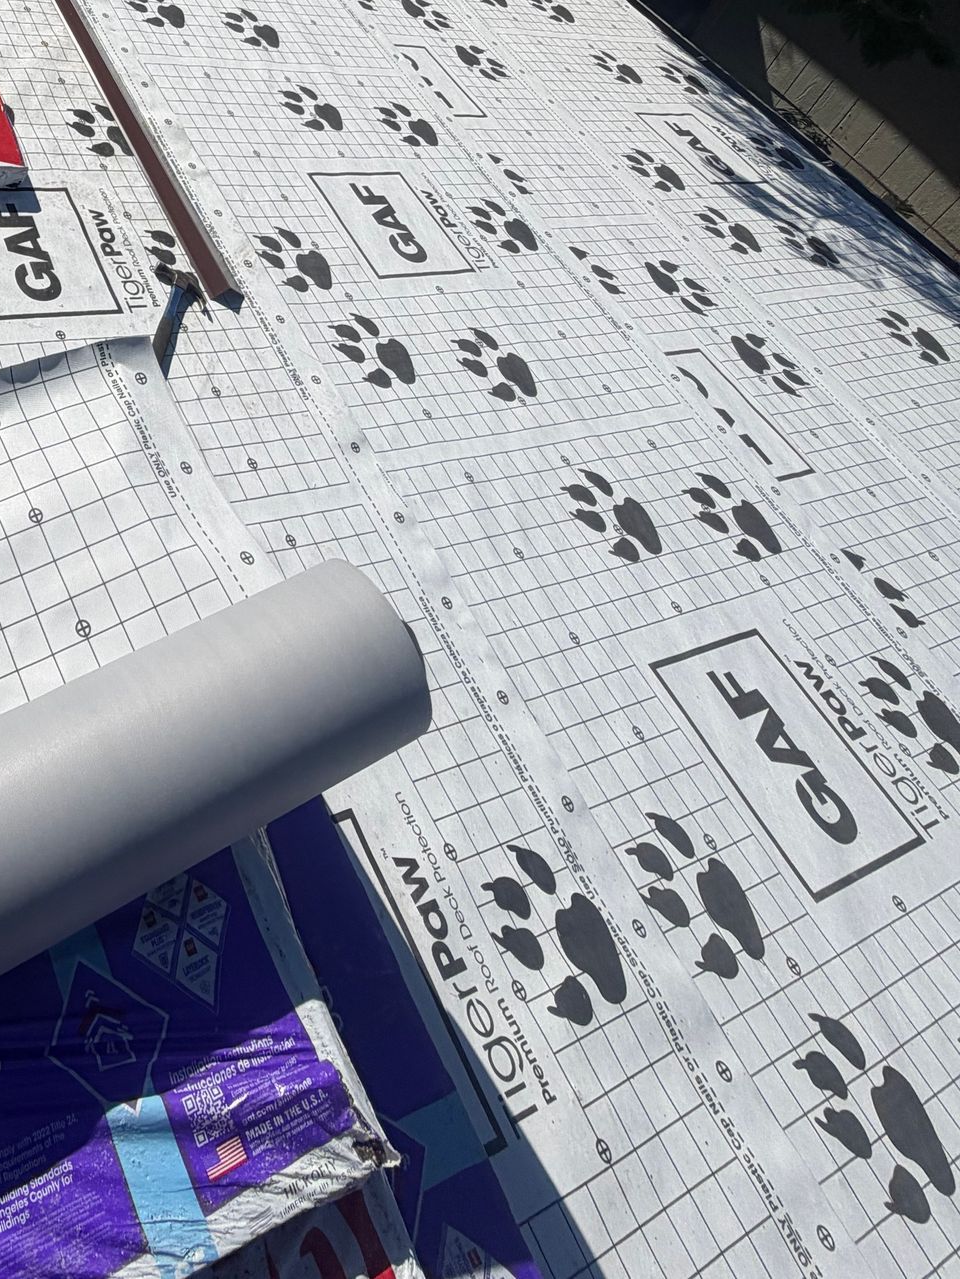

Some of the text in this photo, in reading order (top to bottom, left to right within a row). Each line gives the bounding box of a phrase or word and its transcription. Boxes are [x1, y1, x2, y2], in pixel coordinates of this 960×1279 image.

[663, 121, 736, 176] GAF
[98, 187, 123, 225] Protection
[349, 182, 428, 263] GAF
[420, 189, 490, 272] TigerPaw
[88, 209, 147, 313] TigerPaw
[119, 227, 134, 250] Deck
[138, 268, 161, 307] Premium
[90, 340, 177, 499] Use ONLY Plastic Cap Nails or Plast
[415, 594, 443, 632] Plástica
[436, 632, 464, 669] Cabeza
[458, 668, 473, 685] De
[831, 680, 864, 716] Deck
[467, 684, 495, 723] Grapas
[495, 731, 529, 783] Plásticas
[705, 670, 858, 845] GAF
[793, 660, 940, 839] TigerPaw
[525, 782, 560, 835] Puntillas
[893, 752, 950, 821] Premium
[577, 873, 596, 900] Use
[394, 790, 557, 1106] Premium Roof Deck Protection
[603, 916, 638, 968] Staples
[392, 854, 539, 1140] TigerPaw
[635, 967, 658, 999] Cap
[651, 1000, 687, 1052] Plastic
[682, 1055, 696, 1072] or
[245, 1090, 329, 1140] MADE IN THE U.S.A.
[693, 1073, 720, 1115] Nails
[718, 1115, 744, 1151] Cap
[29, 1181, 60, 1204] County
[62, 1174, 74, 1188] for
[30, 1160, 73, 1189] Standards
[739, 1151, 780, 1212] Plastic
[775, 1214, 812, 1267] ONLY
